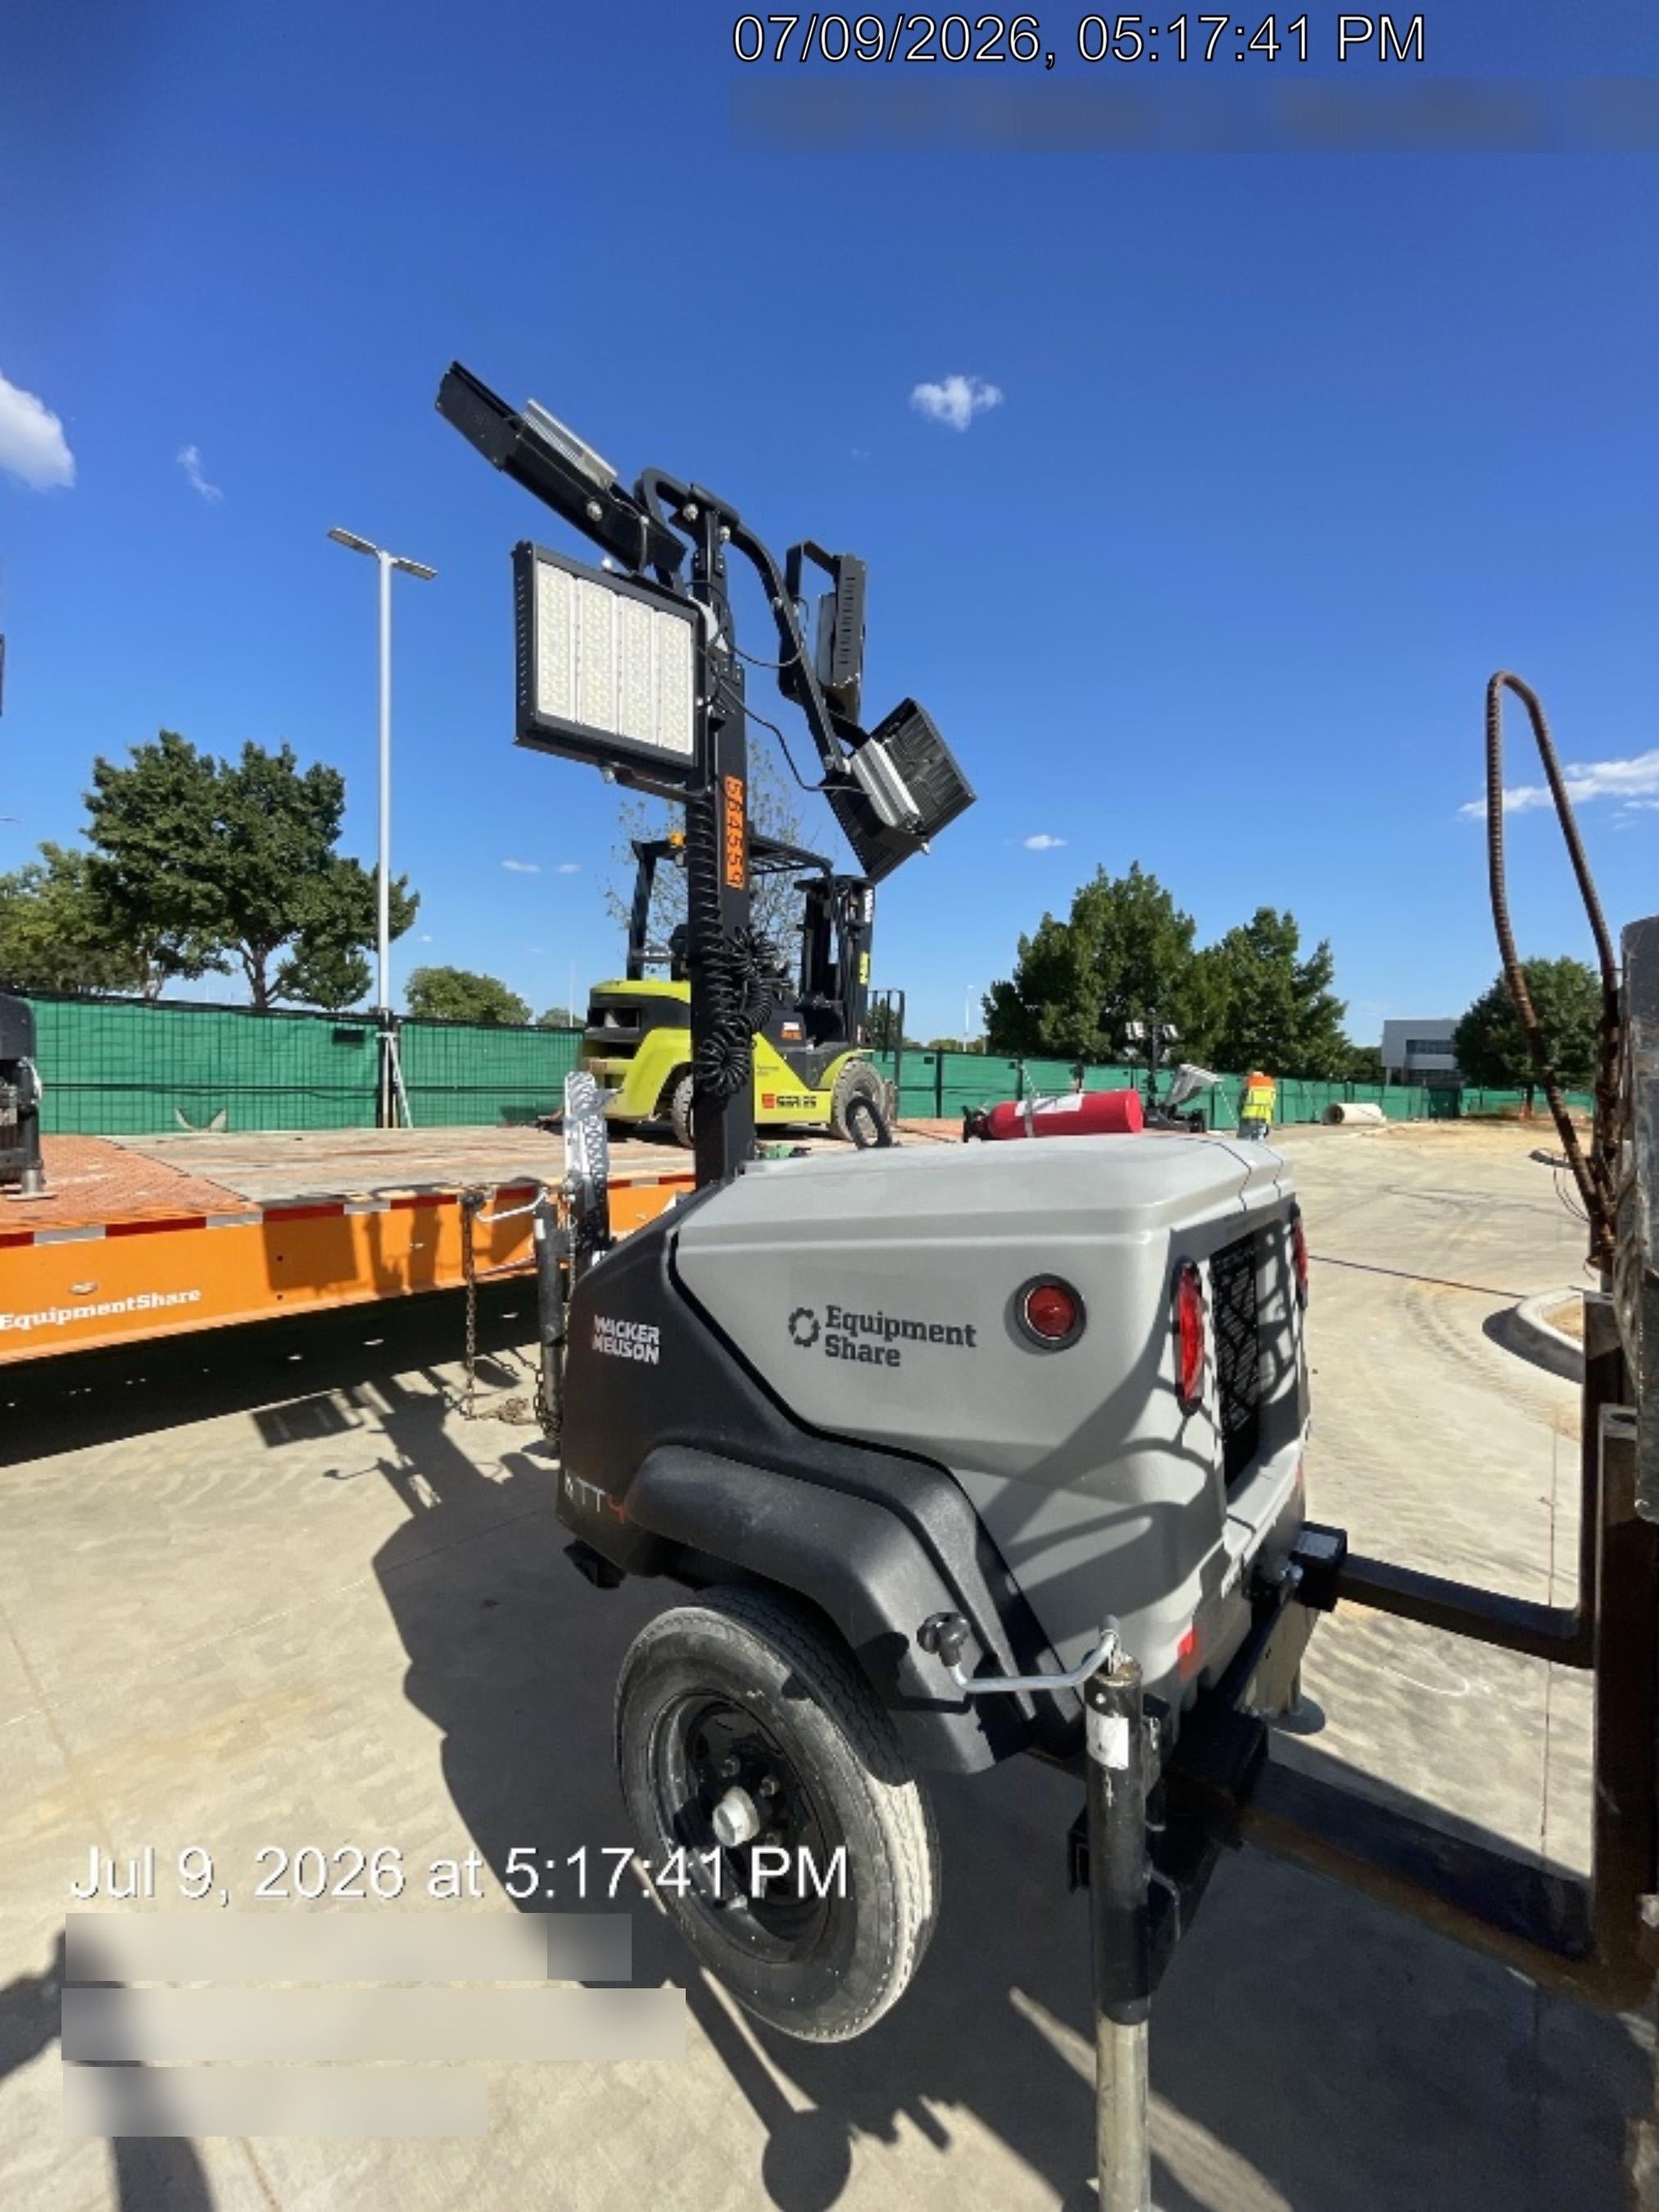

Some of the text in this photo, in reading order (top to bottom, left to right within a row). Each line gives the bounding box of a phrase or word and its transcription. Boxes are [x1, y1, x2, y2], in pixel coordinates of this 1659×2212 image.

[0, 1290, 202, 1330] EquipmentShare
[825, 1305, 977, 1348] Equipment
[594, 1313, 660, 1345] WACKER
[592, 1334, 660, 1365] NEUSON
[825, 1334, 900, 1367] Share
